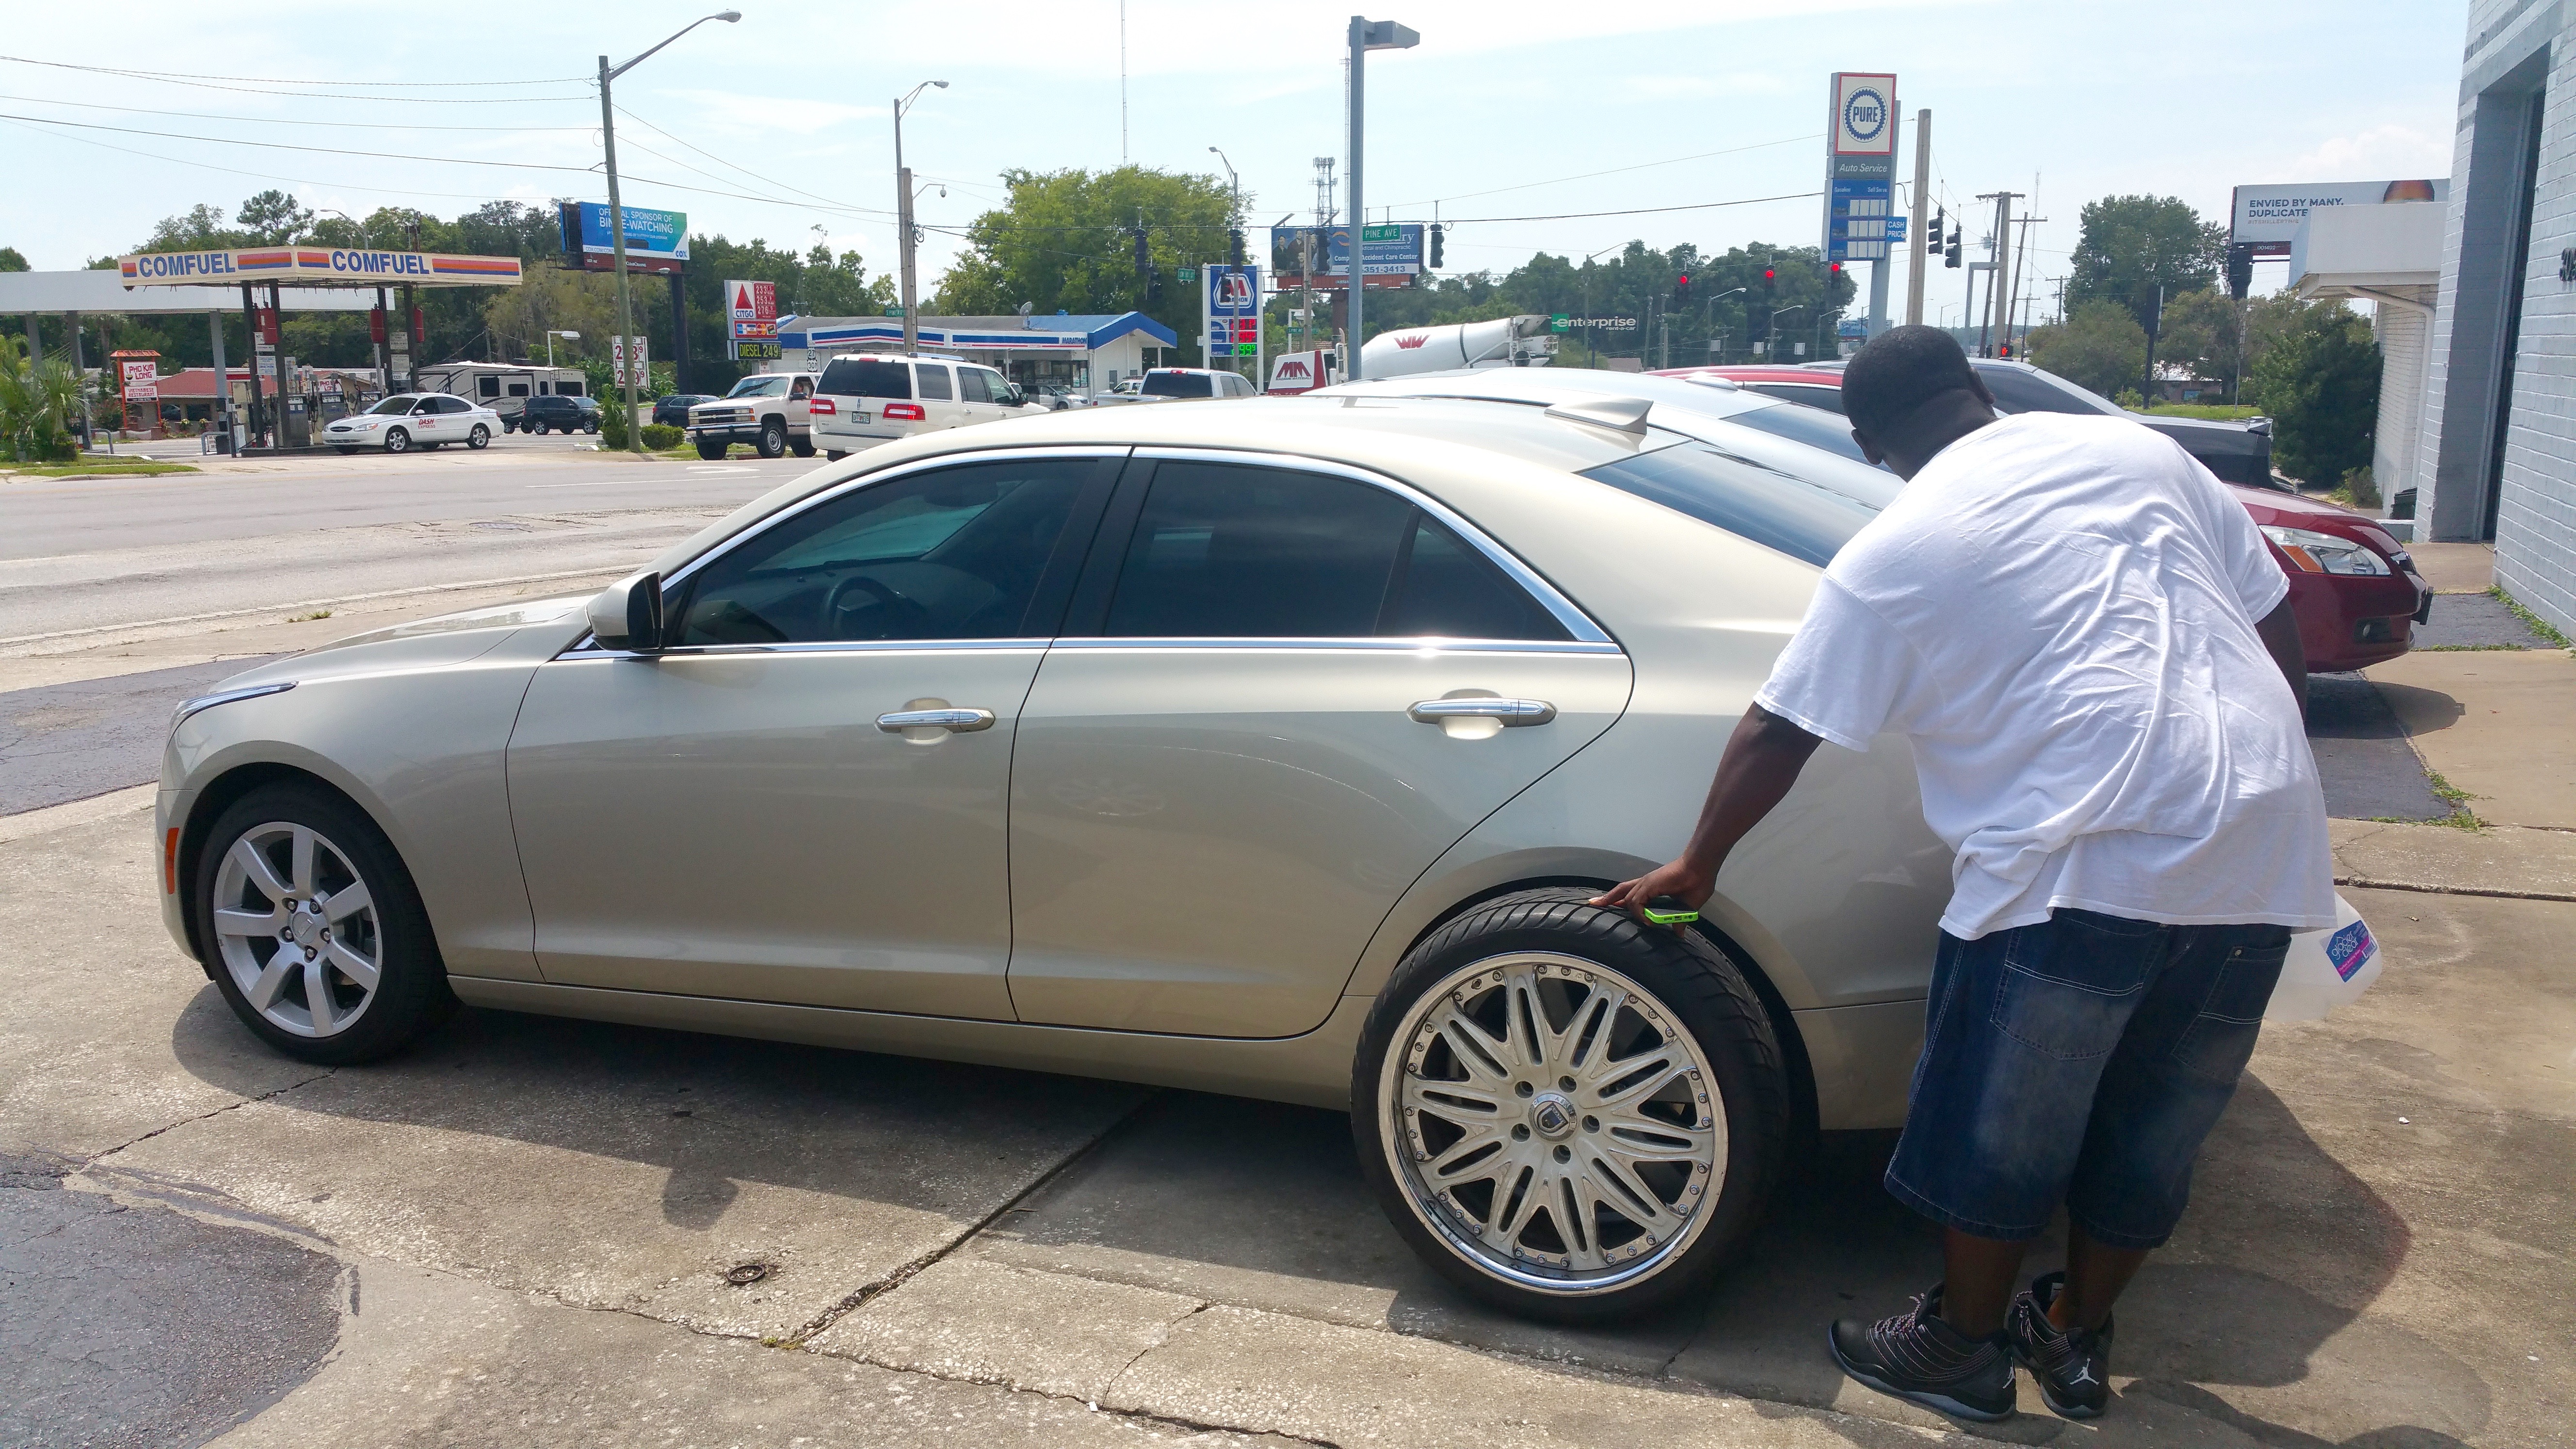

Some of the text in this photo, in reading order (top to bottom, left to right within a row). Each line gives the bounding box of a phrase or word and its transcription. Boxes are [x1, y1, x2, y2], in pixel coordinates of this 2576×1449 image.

[1853, 106, 1878, 122] PURE
[1840, 163, 1887, 173] Auto Service
[2250, 197, 2344, 208] ENVIED BY MANY.
[599, 208, 673, 223] OFFAL SPONSOR OF
[599, 217, 673, 234] BINE-WATCHING
[1365, 228, 1398, 238] PINE AVE
[139, 253, 236, 277] COMFUEL
[332, 251, 430, 275] COMFUEL
[1554, 316, 1636, 329] enterprise
[739, 344, 761, 357] DIESEL
[762, 345, 778, 357] 249
[135, 371, 152, 380] LONG
[1276, 361, 1312, 377] MM
[2332, 931, 2354, 960] glacier
[2342, 937, 2358, 957] clear
